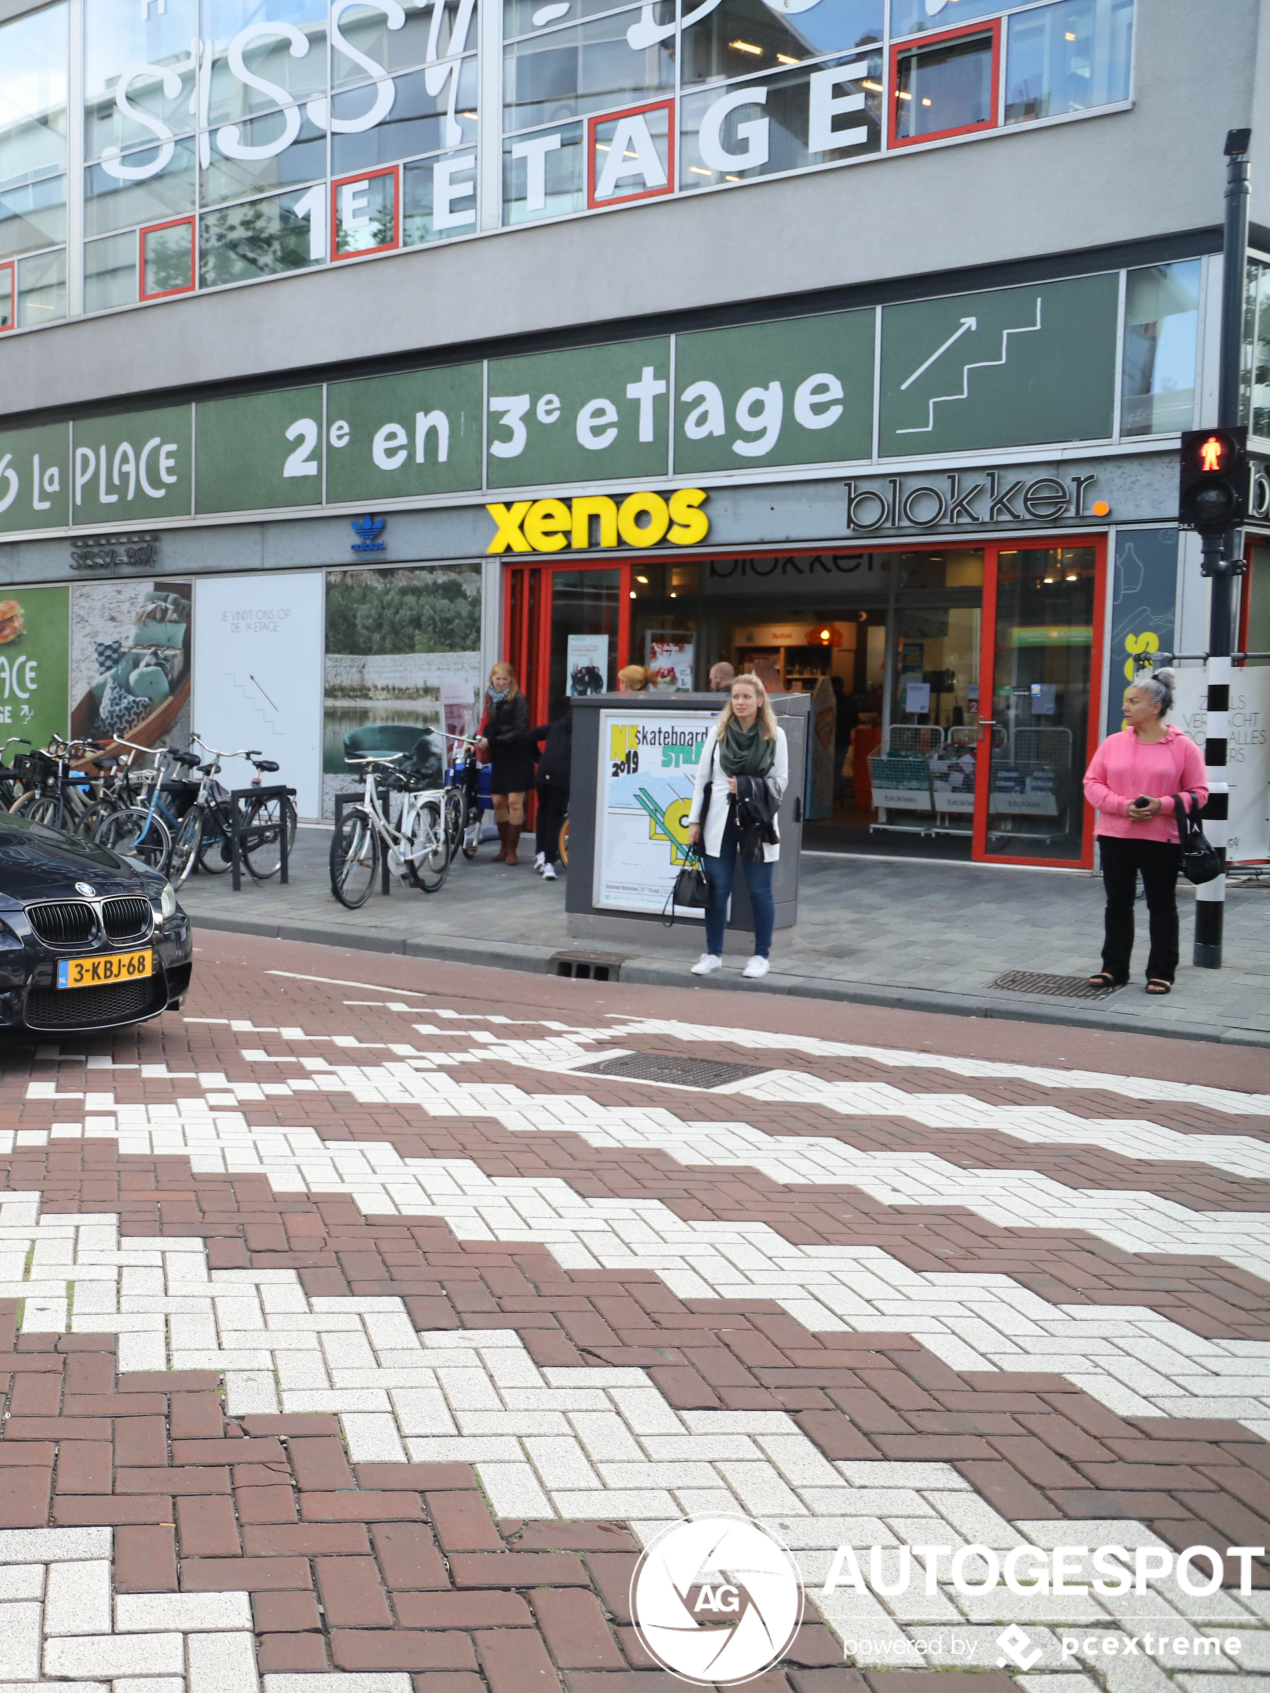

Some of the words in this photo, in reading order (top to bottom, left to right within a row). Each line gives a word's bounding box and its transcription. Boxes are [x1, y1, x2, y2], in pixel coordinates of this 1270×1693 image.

[433, 61, 869, 231] ETAGE
[371, 409, 450, 471] en
[576, 365, 844, 458] etage
[74, 436, 178, 506] PLACE
[485, 487, 709, 554] xenos
[220, 610, 229, 622] JE
[230, 610, 253, 621] VINDT
[255, 609, 275, 620] ONS
[277, 608, 291, 620] OP
[230, 622, 241, 633] DE
[253, 621, 279, 632] ETAGE
[610, 724, 639, 761] NK
[1228, 729, 1267, 745] ALLES
[611, 750, 639, 777] 2019
[73, 954, 146, 983] 3-KBJ-68
